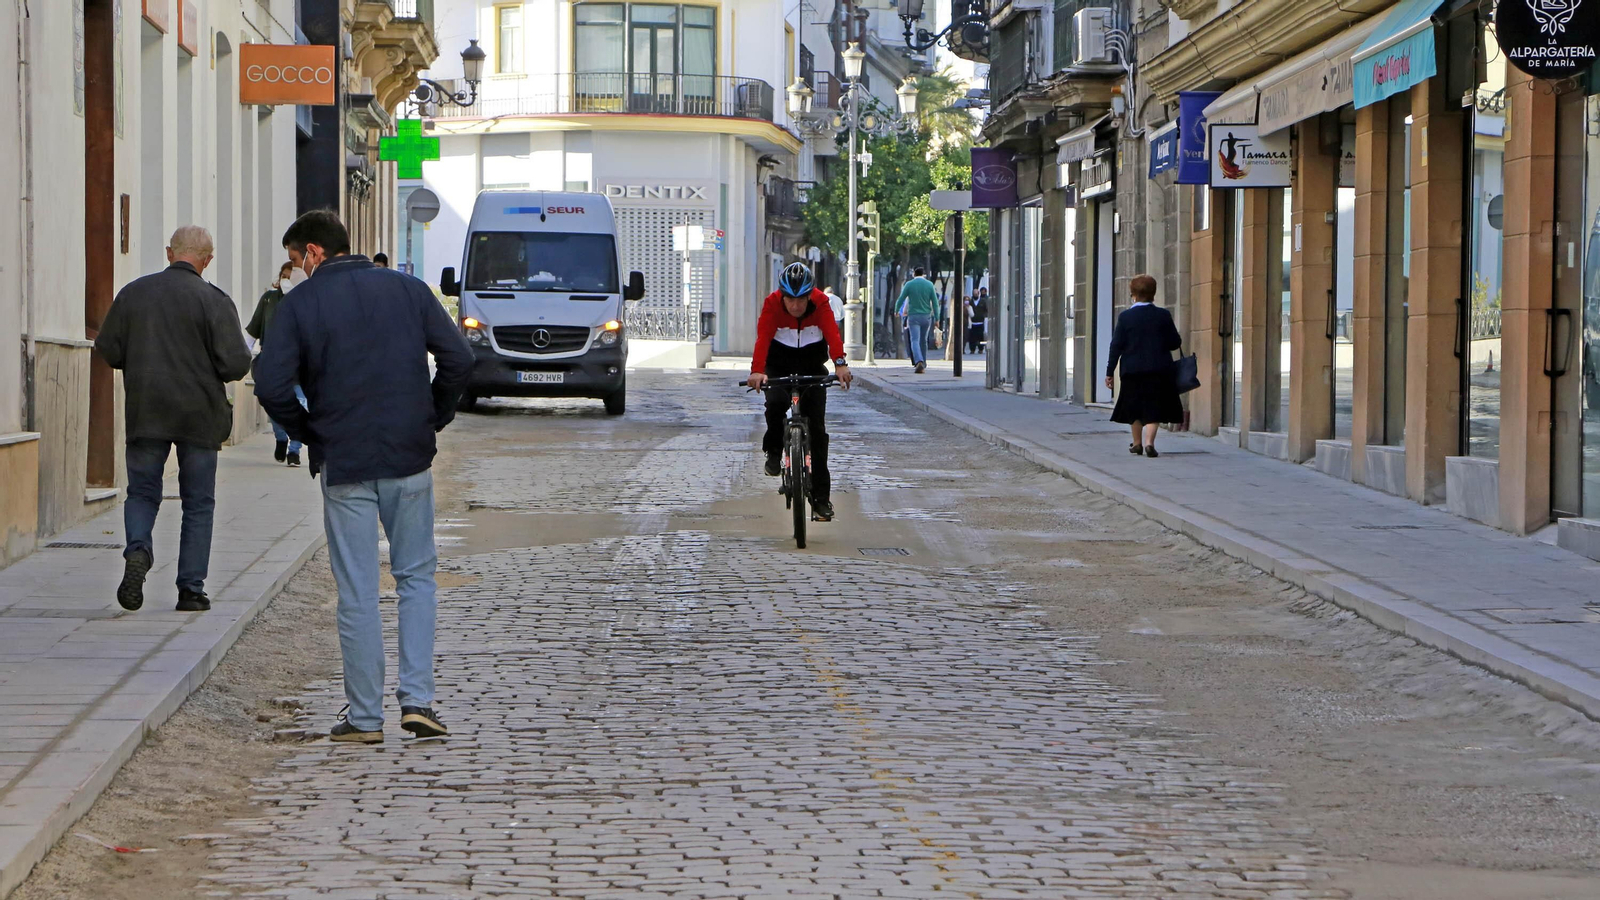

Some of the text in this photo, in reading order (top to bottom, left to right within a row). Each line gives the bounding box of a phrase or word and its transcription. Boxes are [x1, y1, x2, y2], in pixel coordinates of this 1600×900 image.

[1509, 45, 1596, 58] ALPARGATERÍA
[1545, 58, 1576, 67] MARÍA
[246, 64, 332, 84] GOCCO
[1237, 144, 1288, 159] Tamara
[605, 184, 708, 200] DENTIX
[547, 206, 585, 214] SEUR
[523, 373, 562, 382] 4692 HVR
